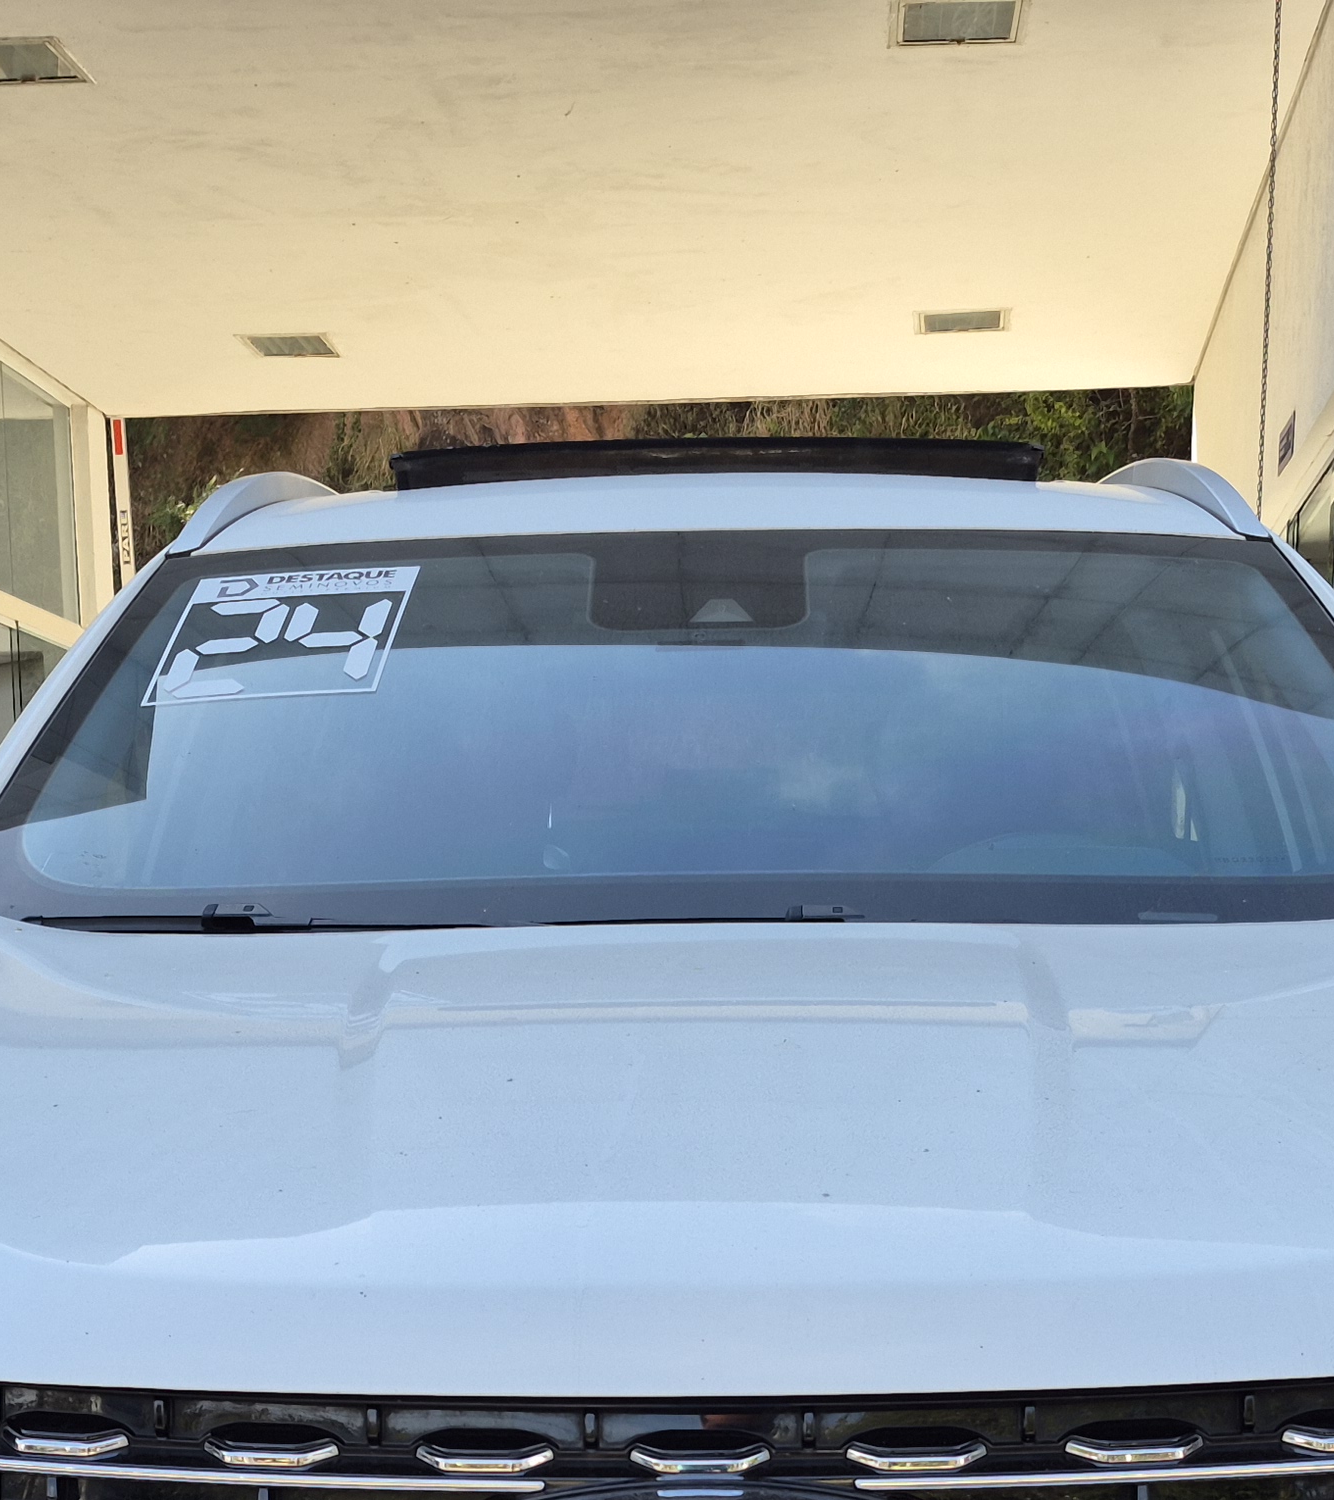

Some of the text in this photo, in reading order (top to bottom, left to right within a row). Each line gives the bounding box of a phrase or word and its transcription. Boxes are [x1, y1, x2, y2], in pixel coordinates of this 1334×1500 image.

[266, 569, 398, 585] DESTAQUE
[262, 578, 394, 593] SEMINOVOS
[164, 599, 393, 699] 24
